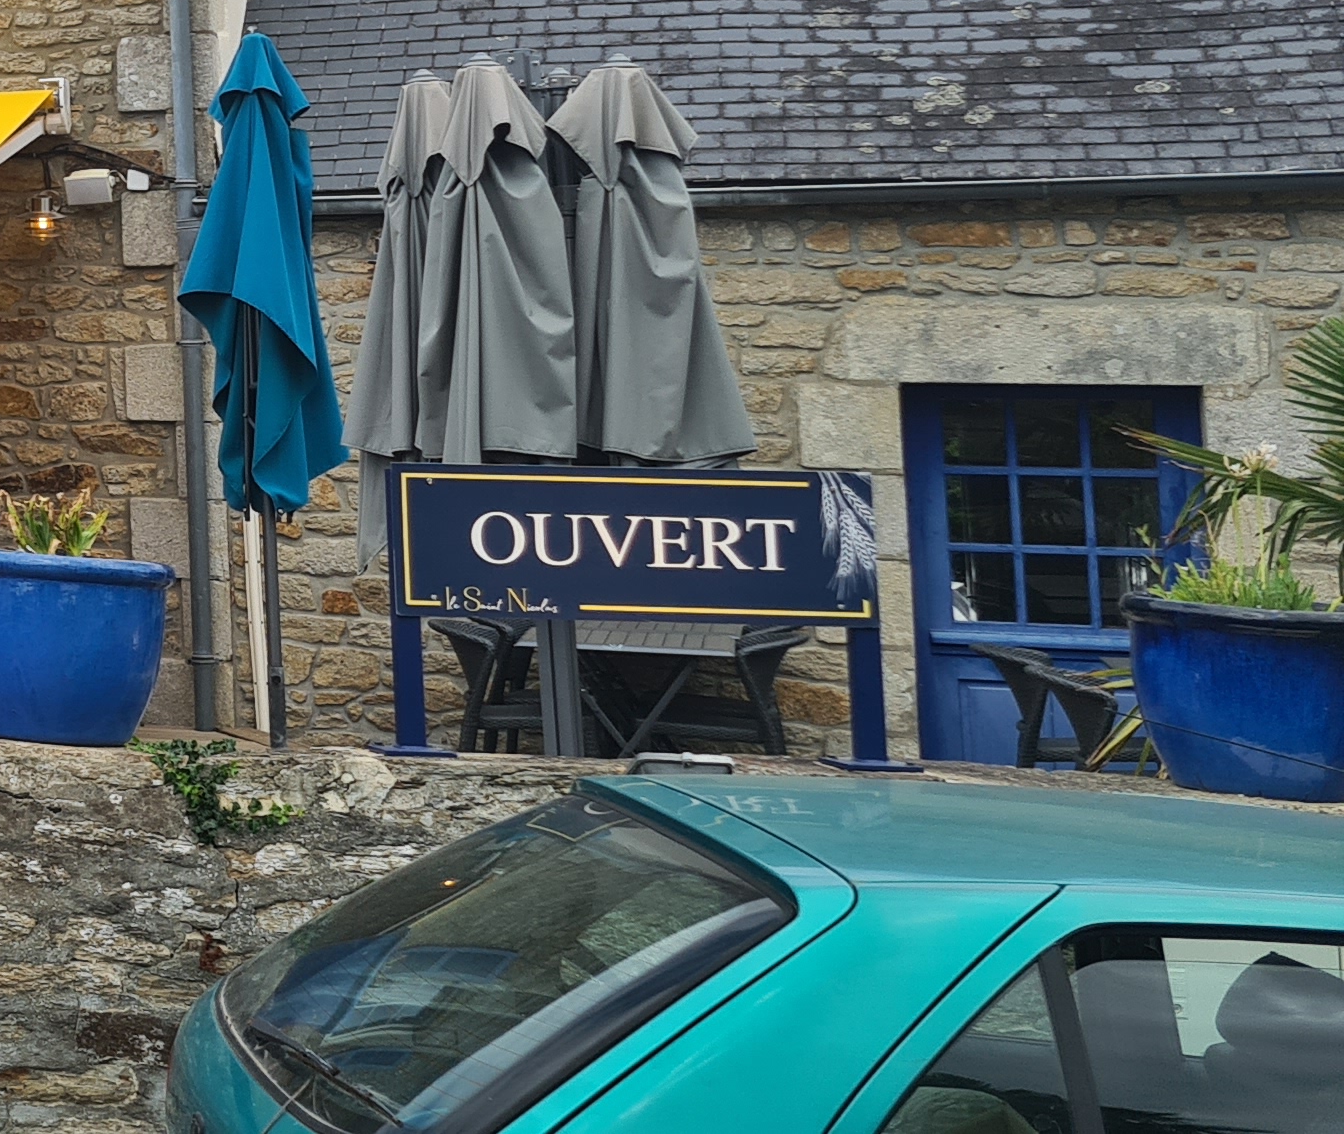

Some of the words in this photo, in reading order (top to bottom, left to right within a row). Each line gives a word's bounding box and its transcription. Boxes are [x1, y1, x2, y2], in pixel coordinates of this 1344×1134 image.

[470, 511, 796, 572] OUVERT
[463, 585, 504, 613] Saint
[506, 586, 559, 615] Nicolas
